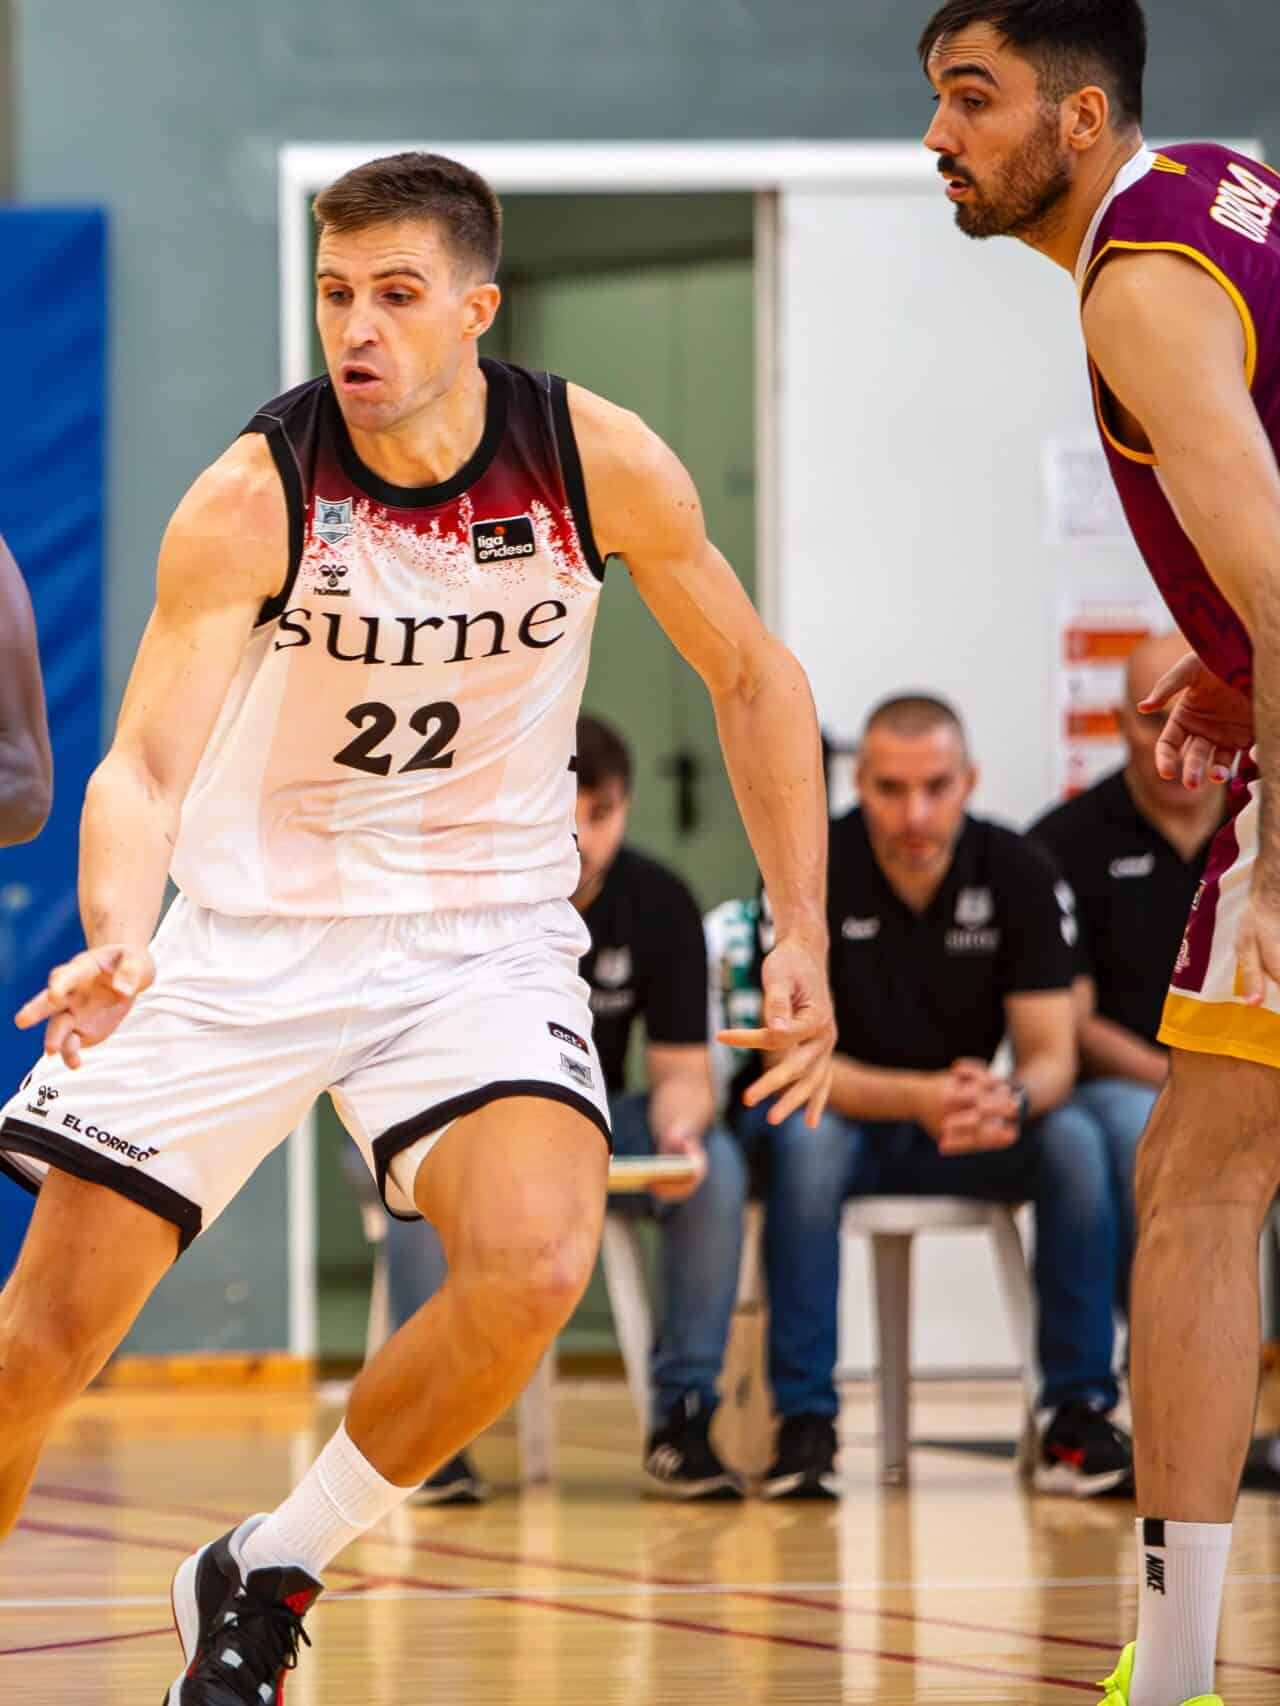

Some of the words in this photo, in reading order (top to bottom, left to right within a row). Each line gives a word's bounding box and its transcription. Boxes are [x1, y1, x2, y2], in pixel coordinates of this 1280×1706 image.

[477, 535, 503, 548] liga
[479, 543, 533, 559] endesa
[274, 599, 567, 666] surne
[333, 700, 460, 776] 22
[61, 1113, 82, 1133] EL
[84, 1125, 150, 1162] CORREO
[1145, 1552, 1165, 1596] NIKE
